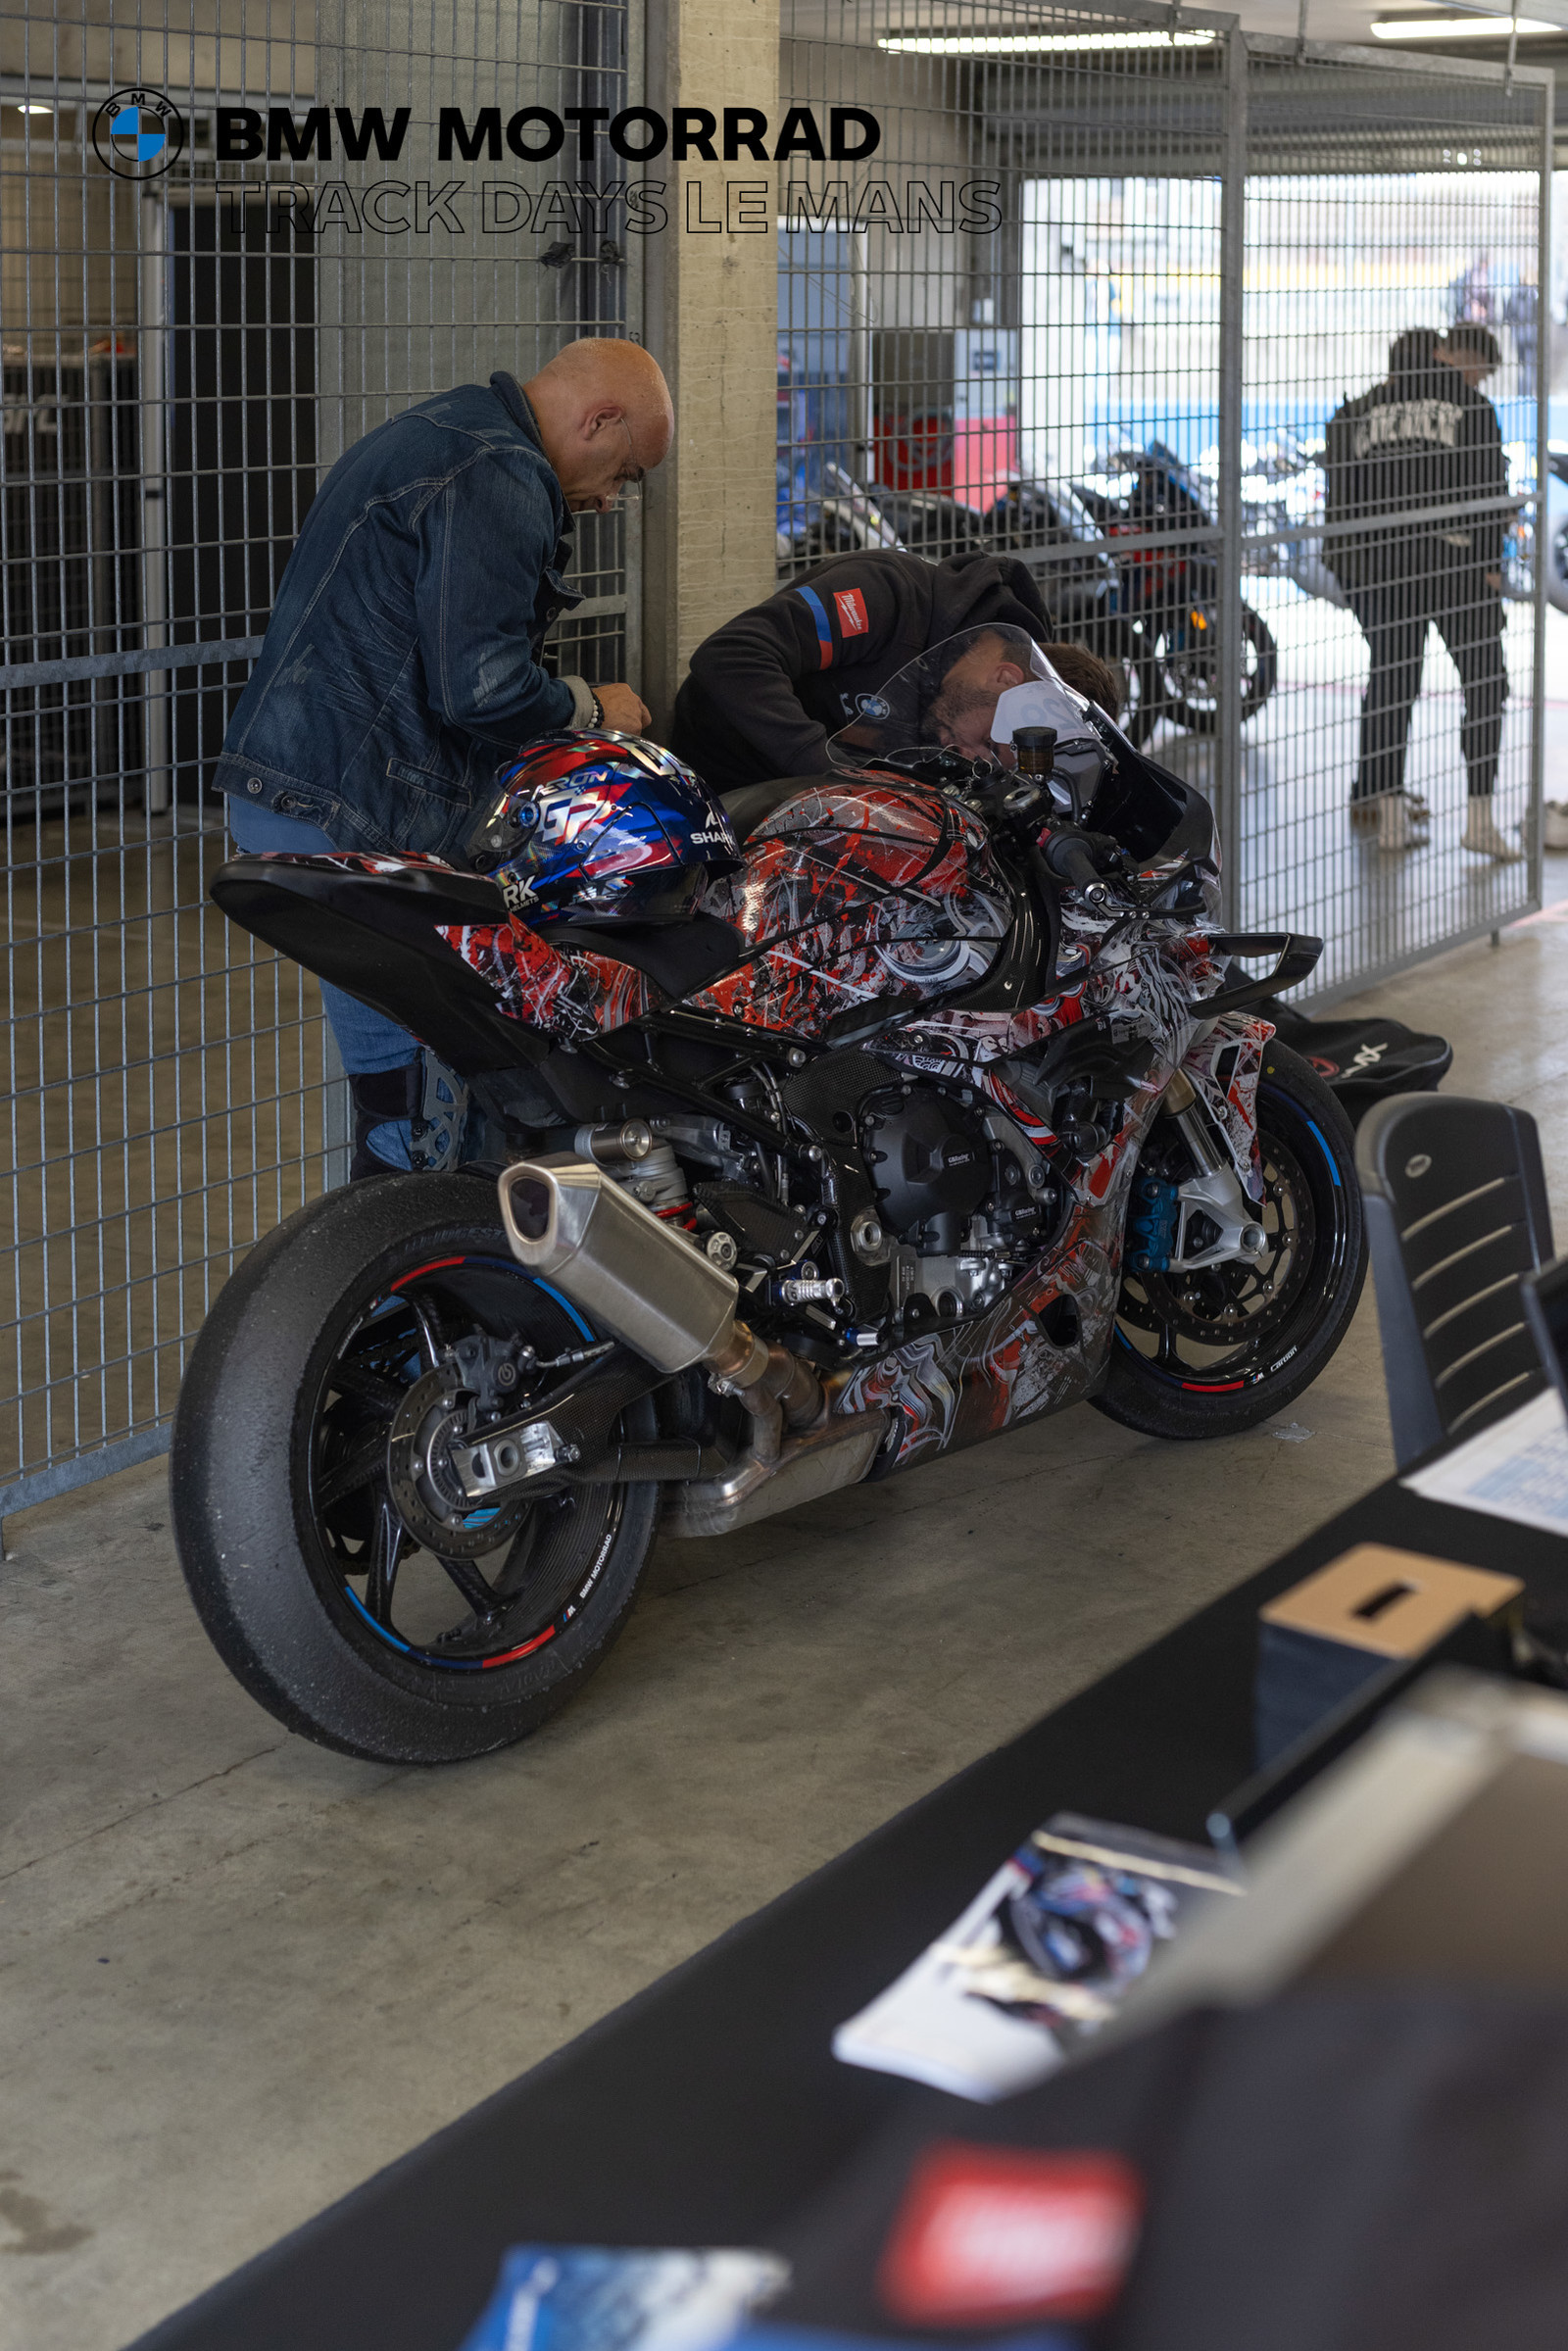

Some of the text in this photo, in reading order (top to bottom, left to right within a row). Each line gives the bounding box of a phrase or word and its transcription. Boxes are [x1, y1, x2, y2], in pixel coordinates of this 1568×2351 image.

[841, 592, 863, 630] Milwaukee
[536, 791, 612, 845] GP
[1270, 1345, 1298, 1372] Carbon
[579, 1578, 594, 1598] BMW
[591, 1534, 612, 1580] MOTORRAD
